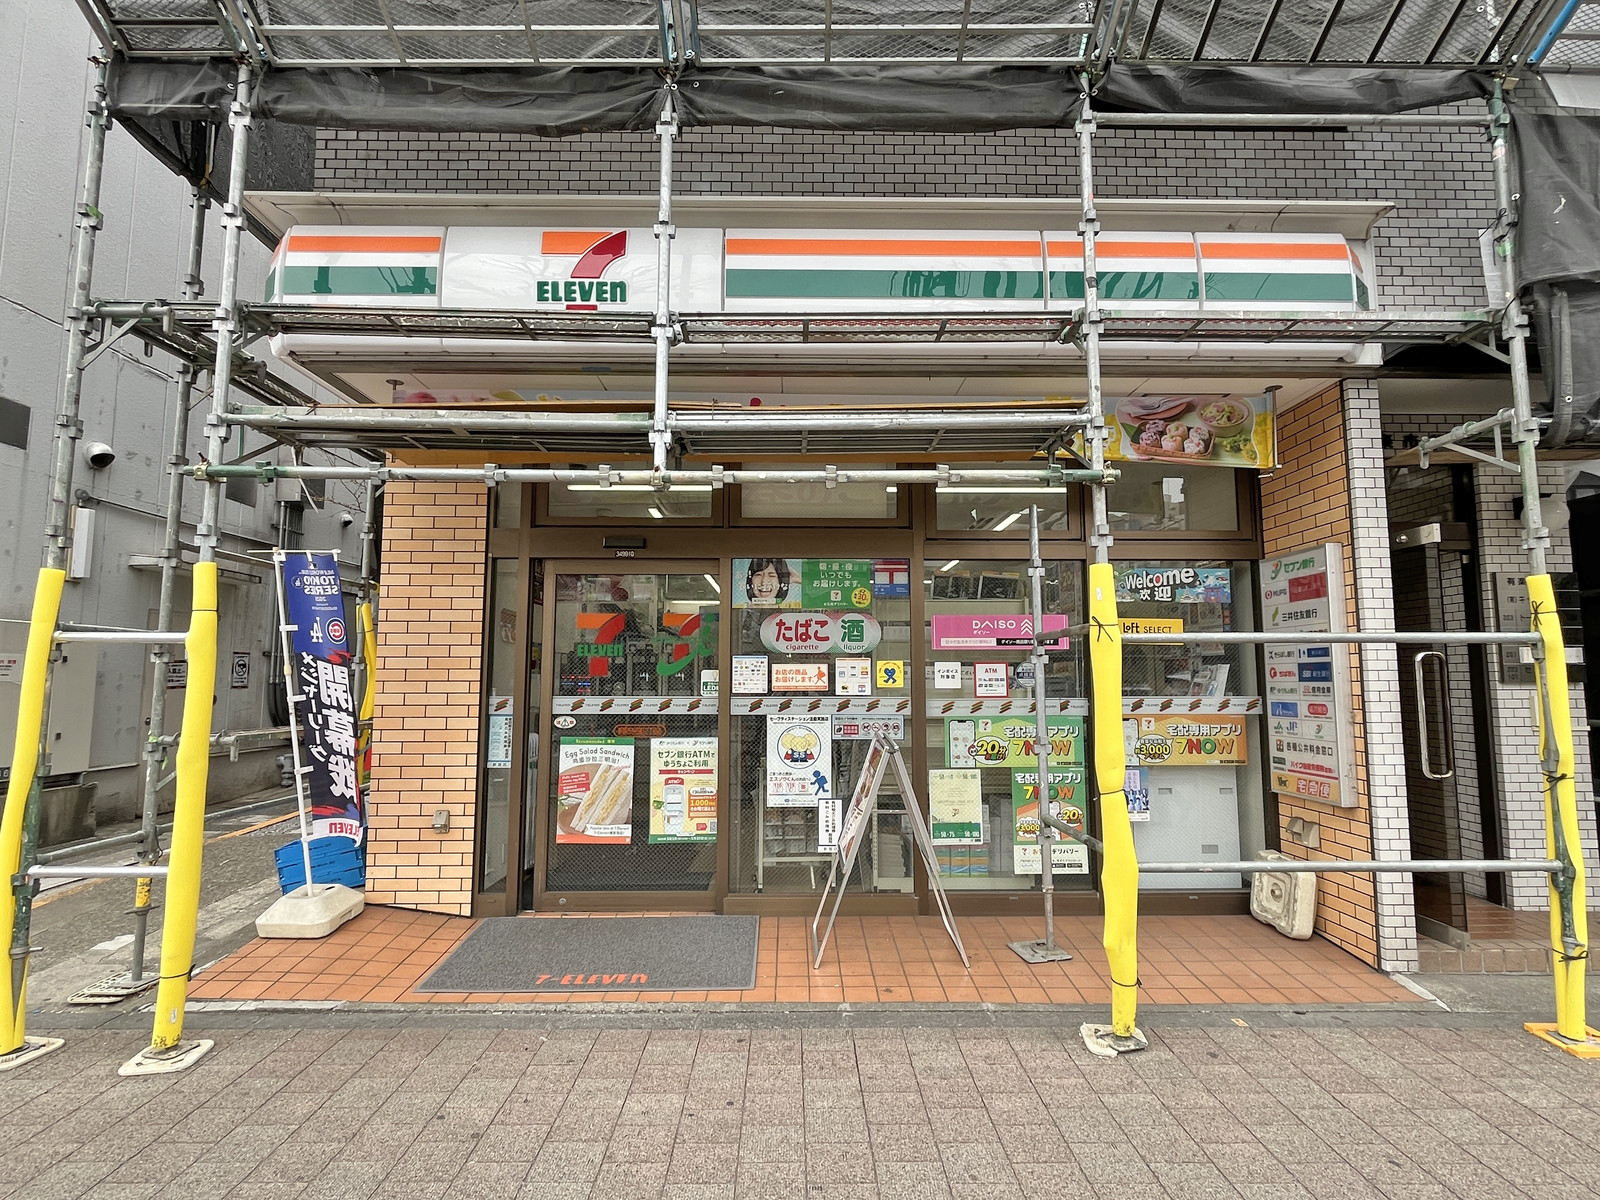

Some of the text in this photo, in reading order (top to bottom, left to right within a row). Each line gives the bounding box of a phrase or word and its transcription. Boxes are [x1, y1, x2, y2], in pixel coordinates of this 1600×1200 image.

[820, 571, 852, 579] いつでも
[1125, 567, 1195, 590] Welcome
[812, 580, 861, 588] お届けします。
[1140, 586, 1173, 601] 欢迎
[1282, 608, 1318, 622] 三井住友銀行
[775, 618, 865, 643] たばこ 酒
[972, 620, 1016, 629] DAISO
[1003, 725, 1080, 738] 宅配専アプリ
[1167, 724, 1242, 736] 宅配専用アプリ
[1012, 740, 1072, 756] 7NW
[1176, 738, 1234, 754] 7NOW
[599, 747, 630, 759] Sandwich
[657, 750, 715, 758] セブン銀行ATMで
[1297, 779, 1330, 797] 宅急便
